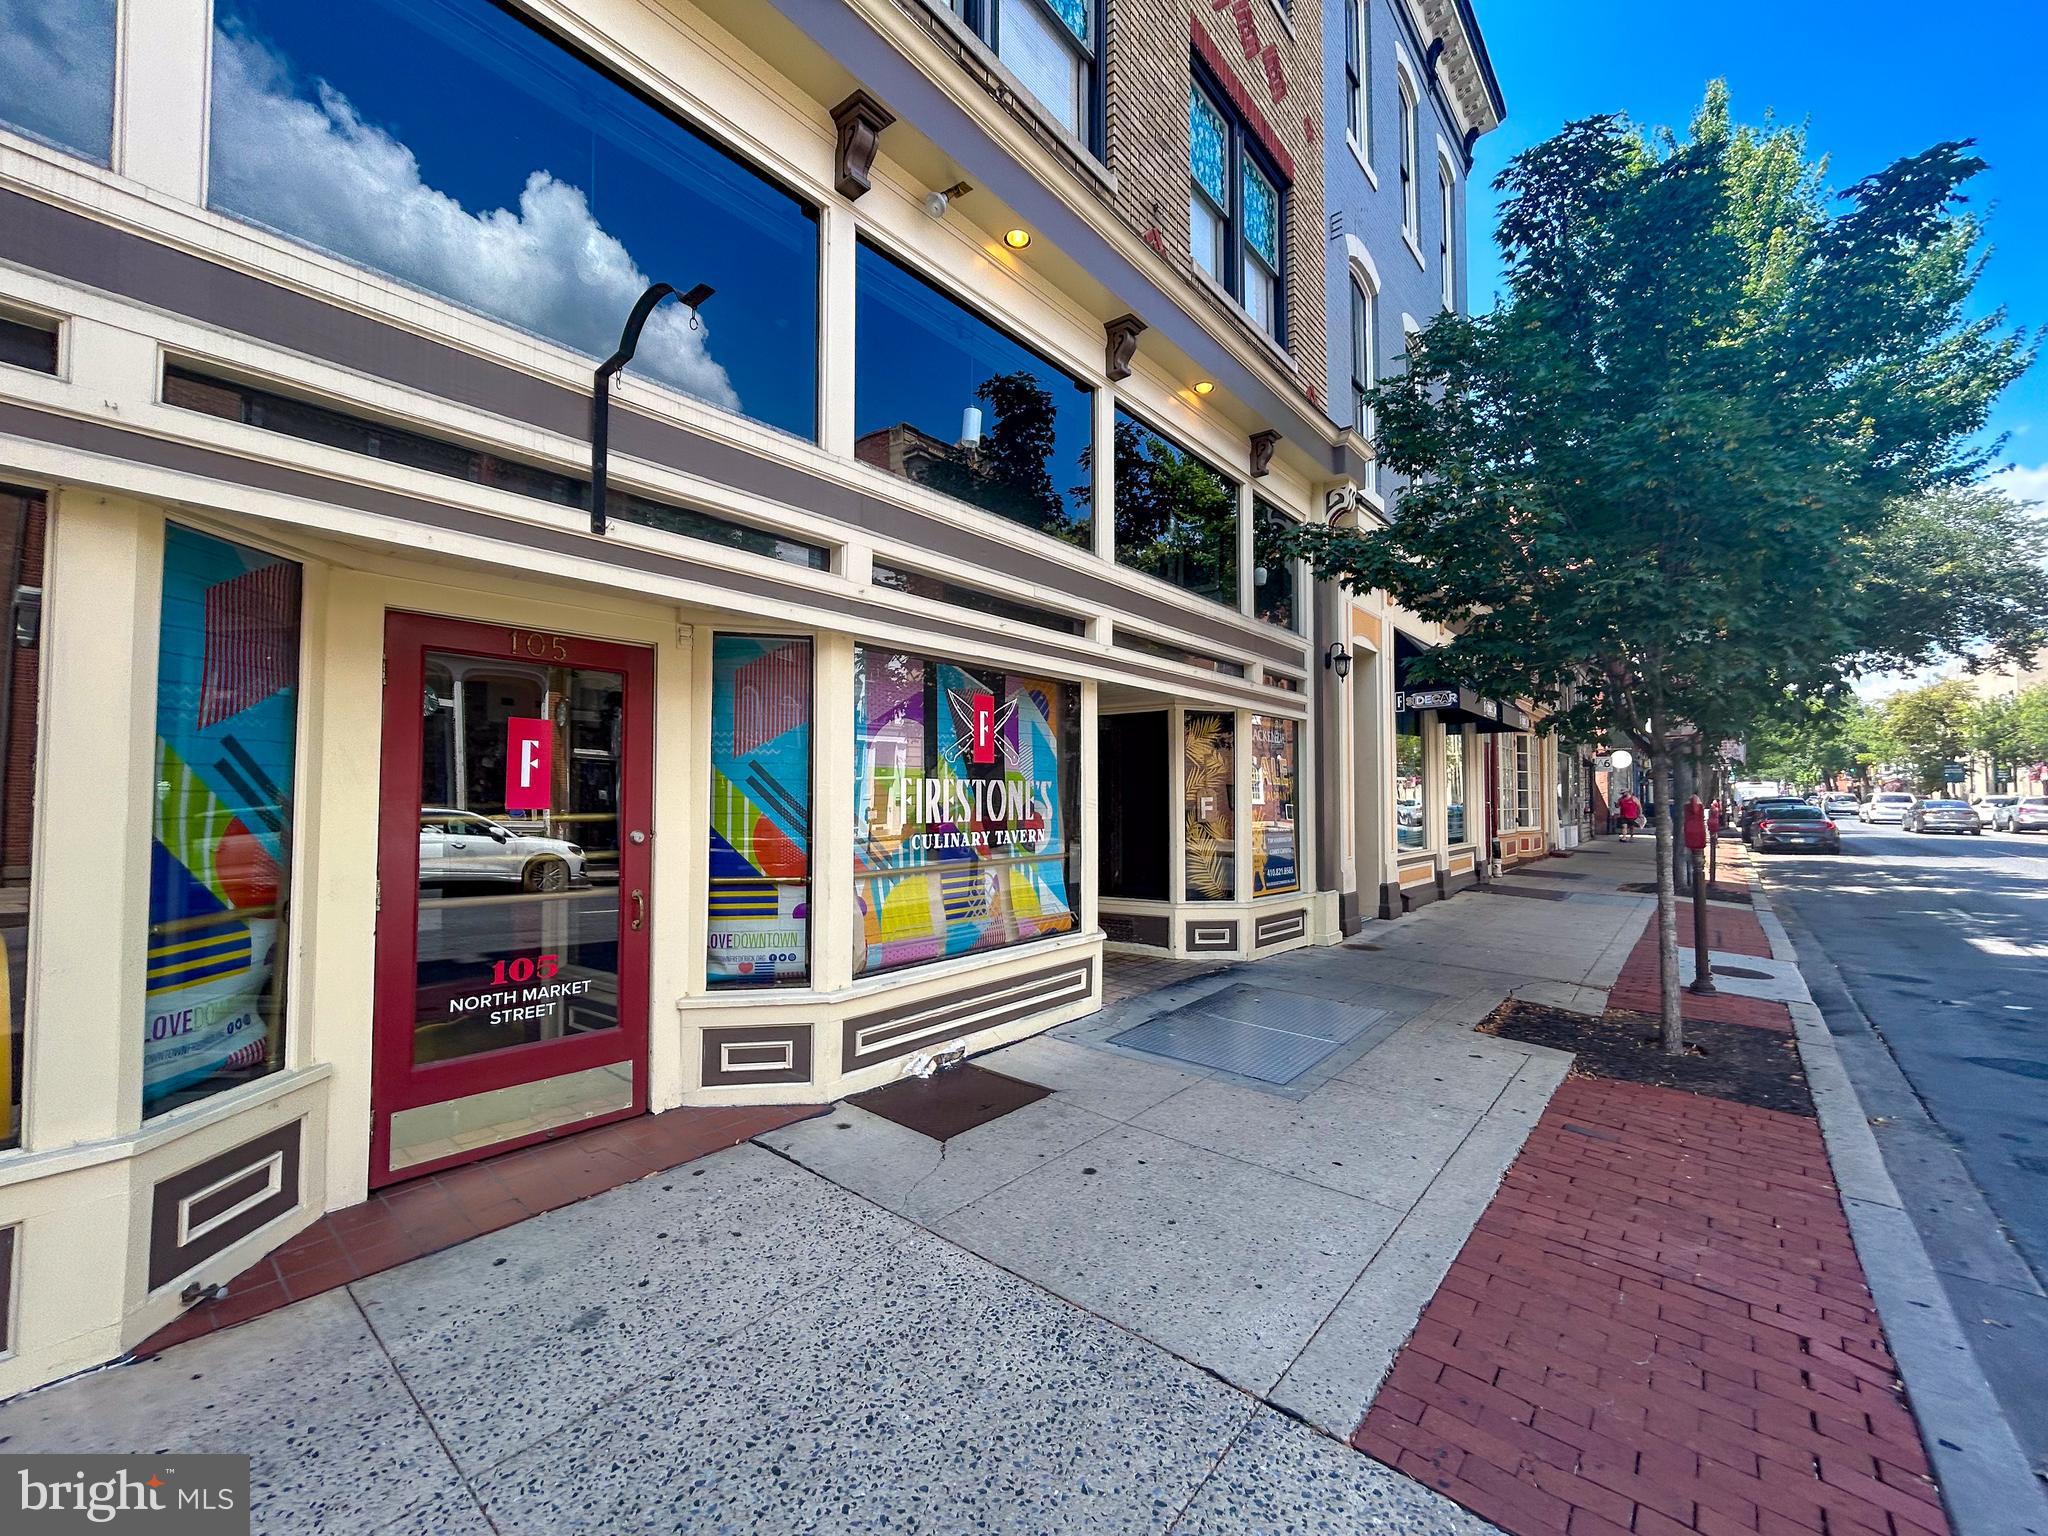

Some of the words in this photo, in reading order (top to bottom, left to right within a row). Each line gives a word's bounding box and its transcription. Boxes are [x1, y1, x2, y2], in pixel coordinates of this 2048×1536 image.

[509, 631, 567, 661] 105
[1406, 692, 1458, 707] SIDECAR
[979, 711, 988, 747] F
[520, 740, 539, 787] F
[900, 778, 1053, 824] FIRESTONE'S
[1201, 796, 1214, 820] F
[911, 830, 992, 850] CULINARY
[993, 829, 1045, 844] TAVERN
[707, 932, 797, 949] OVEDOWNTOWN
[490, 954, 559, 985] 105
[450, 989, 517, 1013] NORTH
[522, 980, 592, 1001] MARKET
[490, 1002, 556, 1025] STREET
